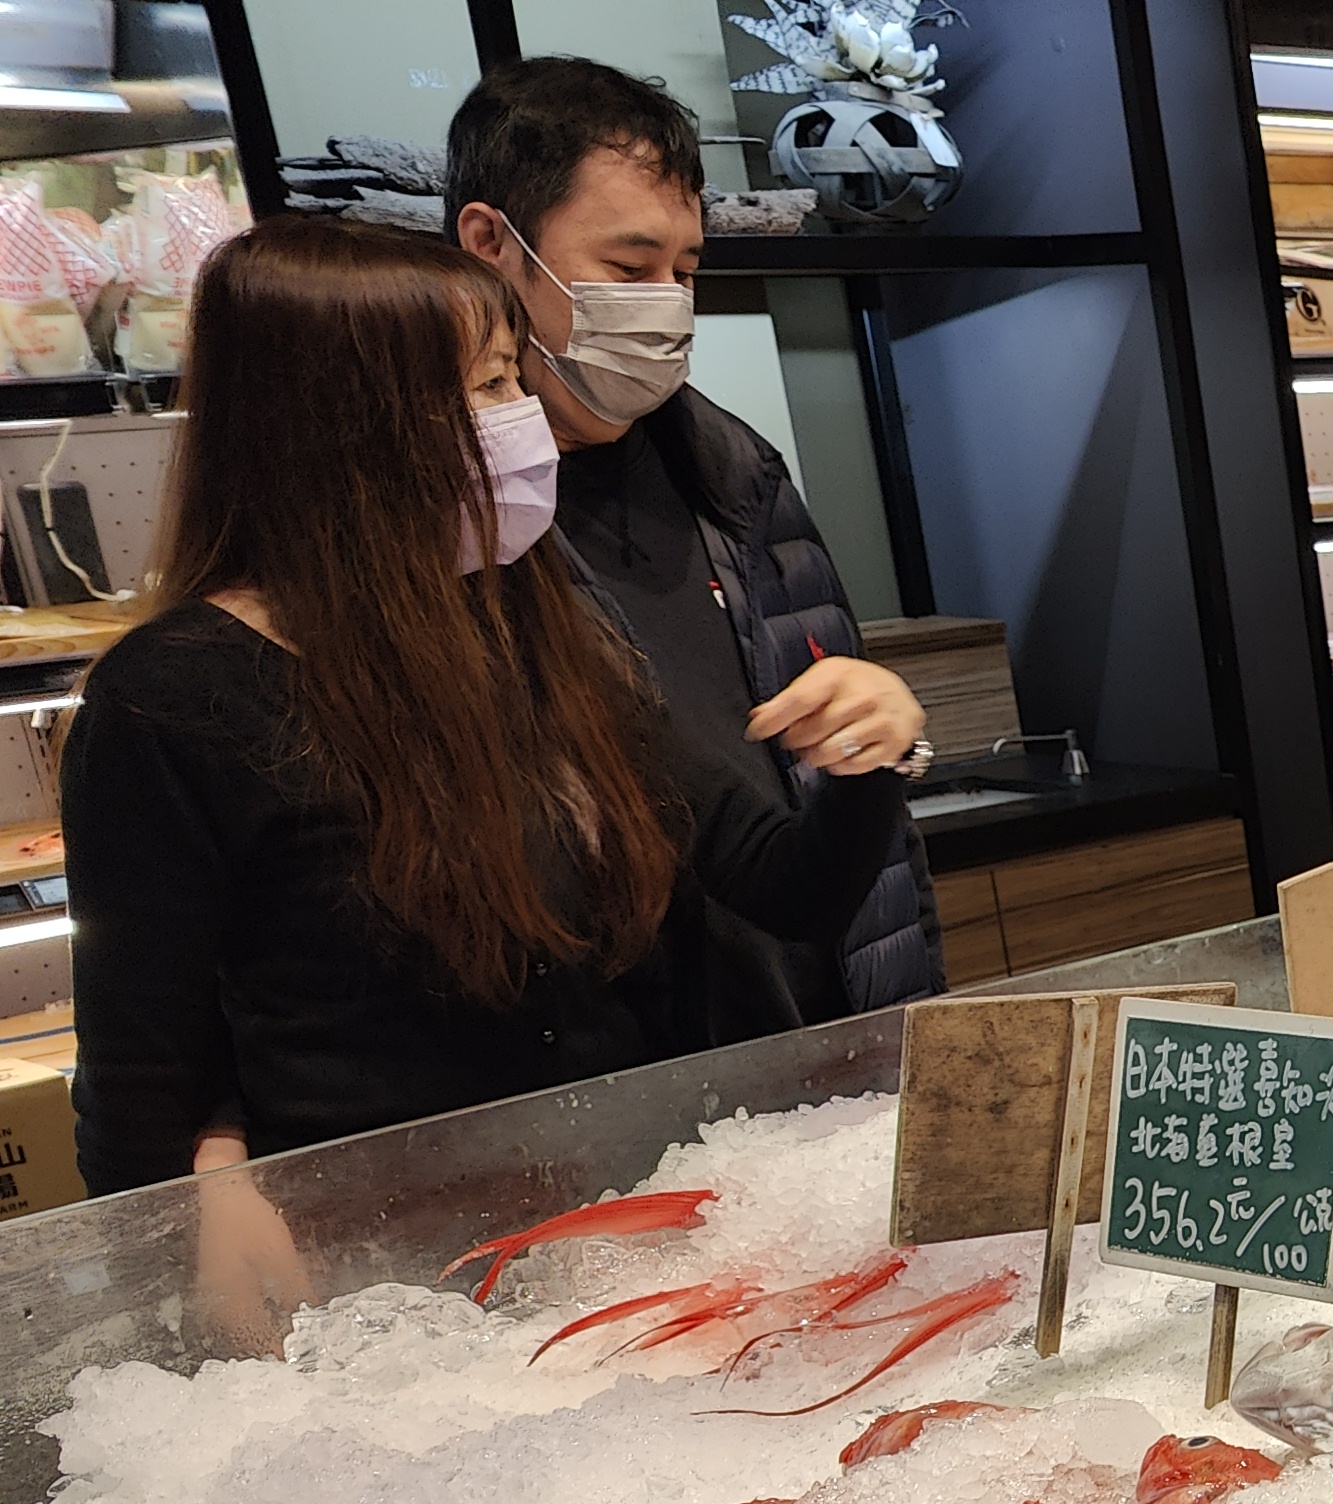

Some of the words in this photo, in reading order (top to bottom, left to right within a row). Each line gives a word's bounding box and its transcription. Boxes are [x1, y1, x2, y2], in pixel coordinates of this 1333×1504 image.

[1129, 1113, 1296, 1171] 北海道根室
